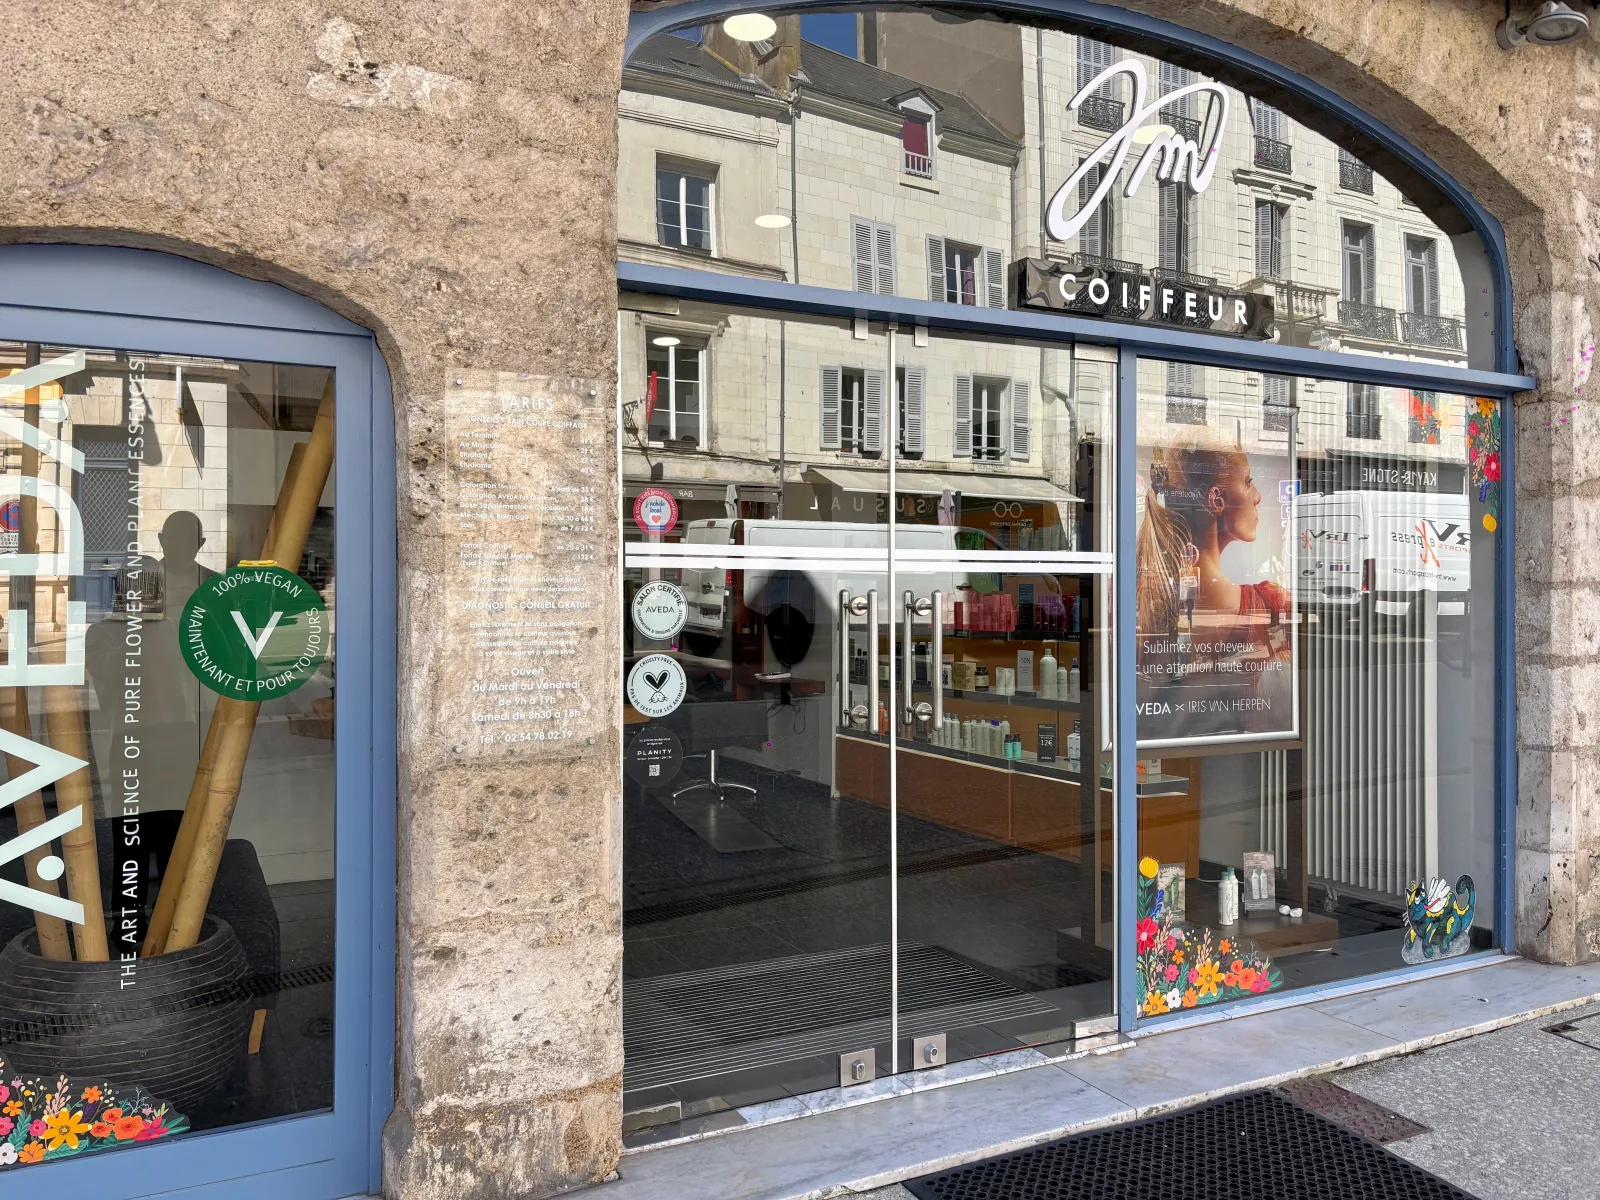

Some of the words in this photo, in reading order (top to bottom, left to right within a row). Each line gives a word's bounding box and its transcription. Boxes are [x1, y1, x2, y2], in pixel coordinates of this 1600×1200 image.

[1059, 273, 1248, 325] COIFFEUR
[128, 358, 146, 461] ESSENCES
[501, 396, 554, 412] TARIFS
[464, 414, 500, 424] CONSEILS
[526, 419, 551, 428] COUPE
[552, 420, 588, 429] COIFFAGE
[127, 469, 144, 533] PLANT
[126, 541, 143, 580] AND
[212, 572, 250, 596] 100%
[254, 571, 302, 598] VEGAN
[636, 586, 656, 606] SALON
[462, 601, 516, 609] DIAGNOSTIC
[126, 590, 142, 667] FLOWER
[188, 606, 235, 686] MAINTENANT
[235, 678, 253, 692] ET
[256, 670, 296, 692] POUR
[292, 607, 322, 673] TOUJOURS
[1143, 640, 1192, 654] Sublimez
[1194, 644, 1212, 653] vos
[1214, 640, 1254, 652] cheveux
[511, 667, 544, 676] Ouvert
[640, 657, 660, 667] CRUELTY
[661, 657, 672, 665] FREE
[1143, 665, 1163, 674] une
[1166, 661, 1212, 674] attention
[1214, 661, 1242, 672] haute
[1245, 660, 1282, 672] couture
[473, 683, 486, 692] du
[488, 682, 518, 691] Mardi
[536, 680, 580, 690] Vendredi
[640, 704, 651, 713] TEST
[673, 682, 684, 705] ANIMAUX
[124, 676, 142, 724] PURE
[498, 698, 512, 706] de
[515, 697, 526, 705] 9h
[540, 696, 556, 705] 19h
[1136, 702, 1172, 715] VEDA
[1188, 700, 1206, 713] IRIS
[1209, 700, 1229, 712] VAN
[1232, 698, 1271, 711] HERPEN
[472, 712, 510, 722] Samedi
[512, 711, 525, 720] de
[528, 710, 552, 720] 8h30
[564, 709, 580, 718] 18h
[124, 735, 141, 759] OF
[504, 730, 573, 743] 02.54.78.02.19
[122, 768, 141, 846] SCIENCE
[122, 860, 139, 899] AND
[121, 906, 138, 944] ART
[120, 951, 137, 990] THE
